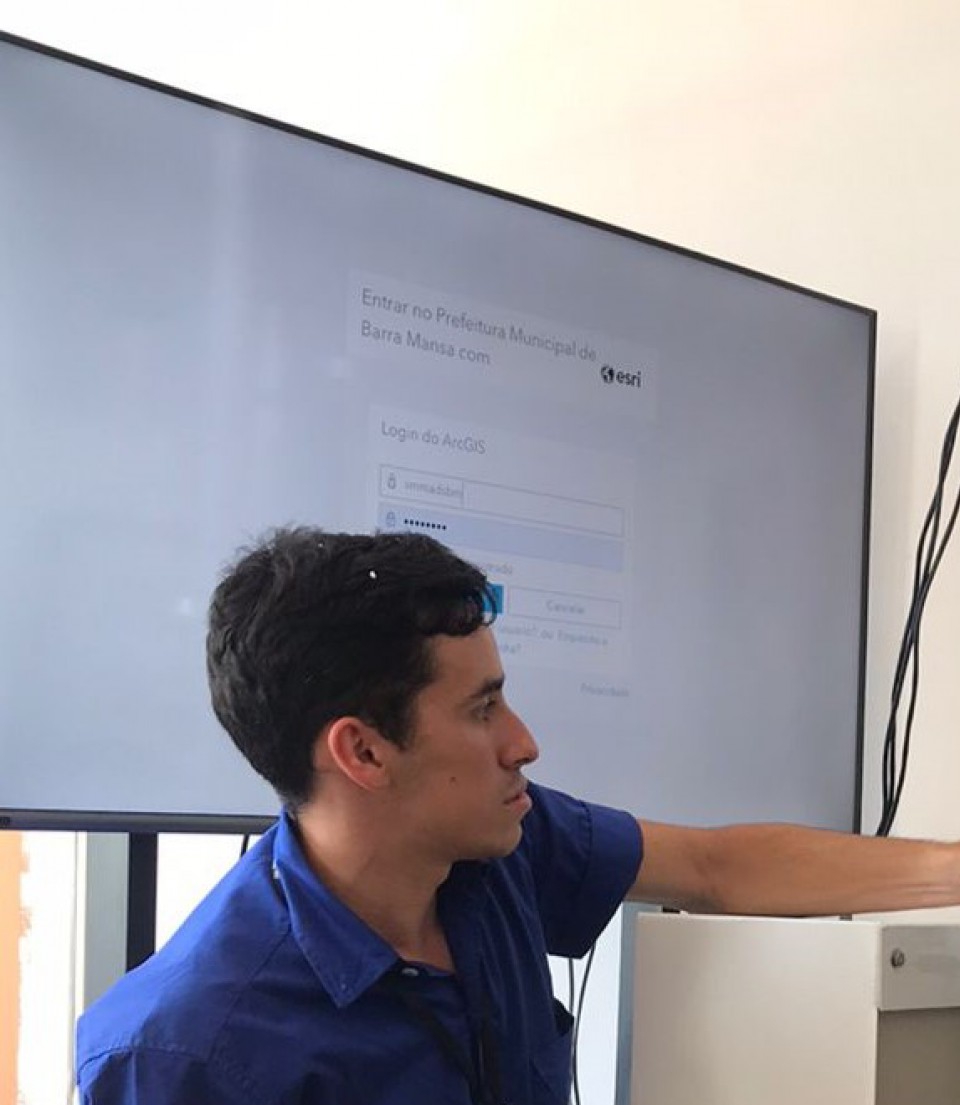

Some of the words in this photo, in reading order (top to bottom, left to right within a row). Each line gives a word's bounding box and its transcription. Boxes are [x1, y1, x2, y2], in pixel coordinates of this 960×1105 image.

[361, 320, 402, 345] Barra
[407, 330, 455, 357] Mansa
[458, 346, 491, 365] com
[362, 288, 407, 314] Entrar
[412, 304, 433, 321] no
[436, 307, 506, 340] Prefeitura
[509, 326, 576, 358] Municipal
[578, 345, 597, 362] de
[615, 370, 642, 387] esri
[381, 421, 418, 443] Login
[422, 427, 440, 446] do
[442, 431, 487, 455] ArcGIS
